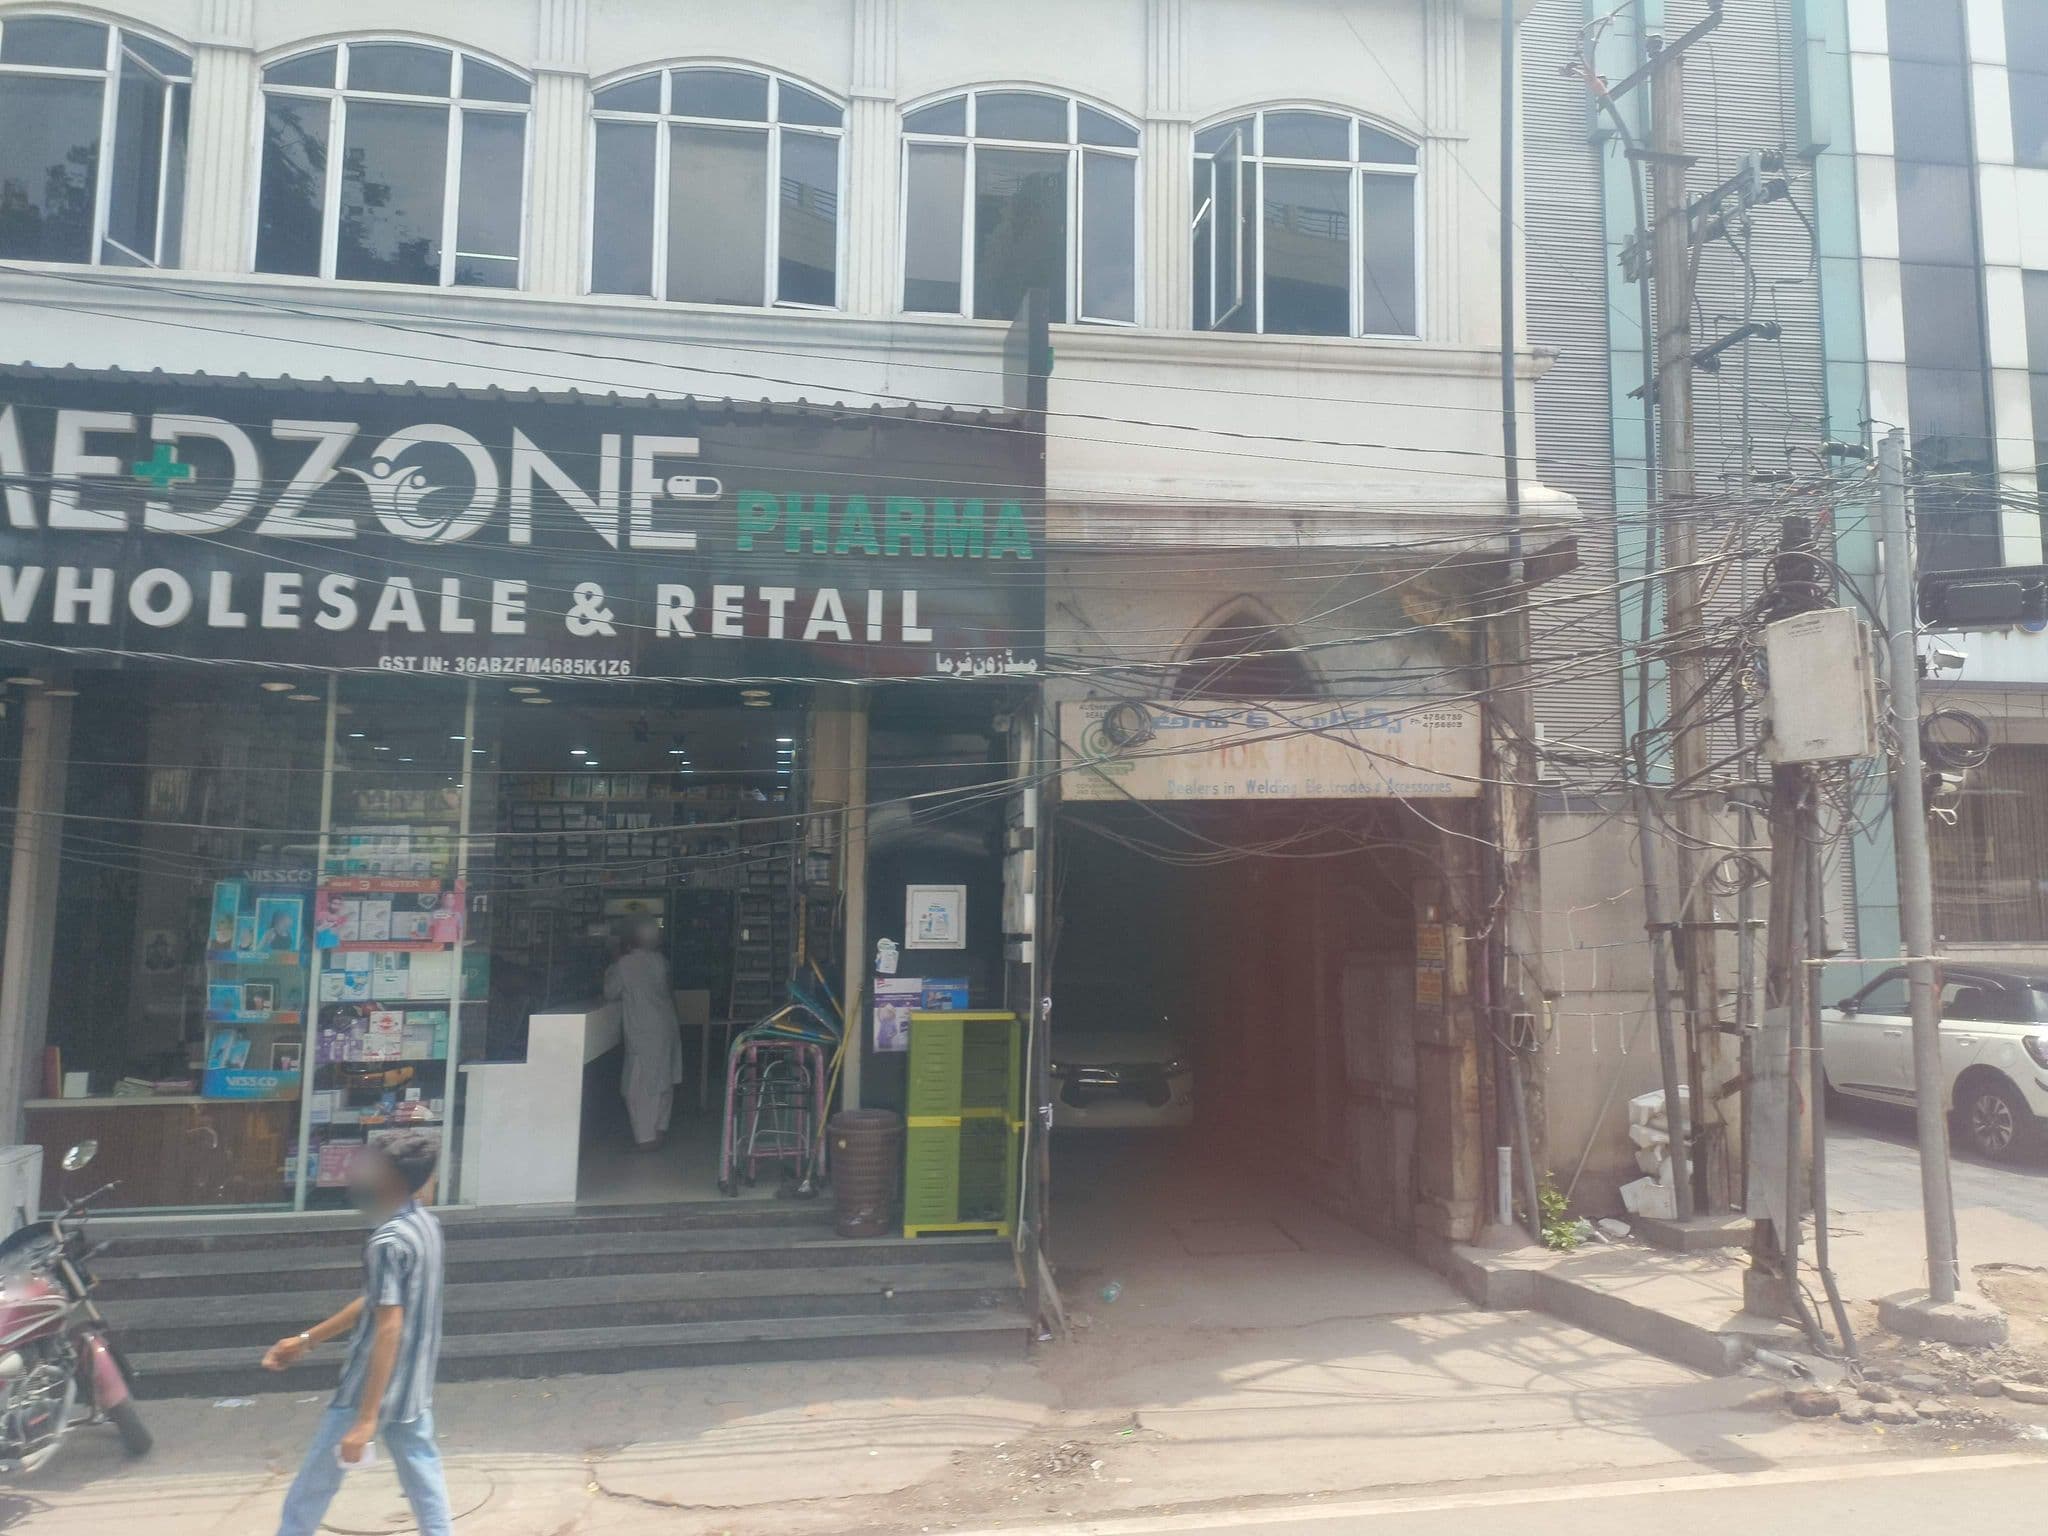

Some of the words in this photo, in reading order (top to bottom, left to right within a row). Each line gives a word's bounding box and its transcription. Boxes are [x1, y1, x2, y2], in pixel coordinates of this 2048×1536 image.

[737, 489, 1034, 560] PHARMA
[564, 581, 618, 638] &
[656, 583, 933, 643] RETAIL
[378, 655, 418, 672] GST
[422, 656, 450, 673] IN:
[1223, 780, 1235, 794] in
